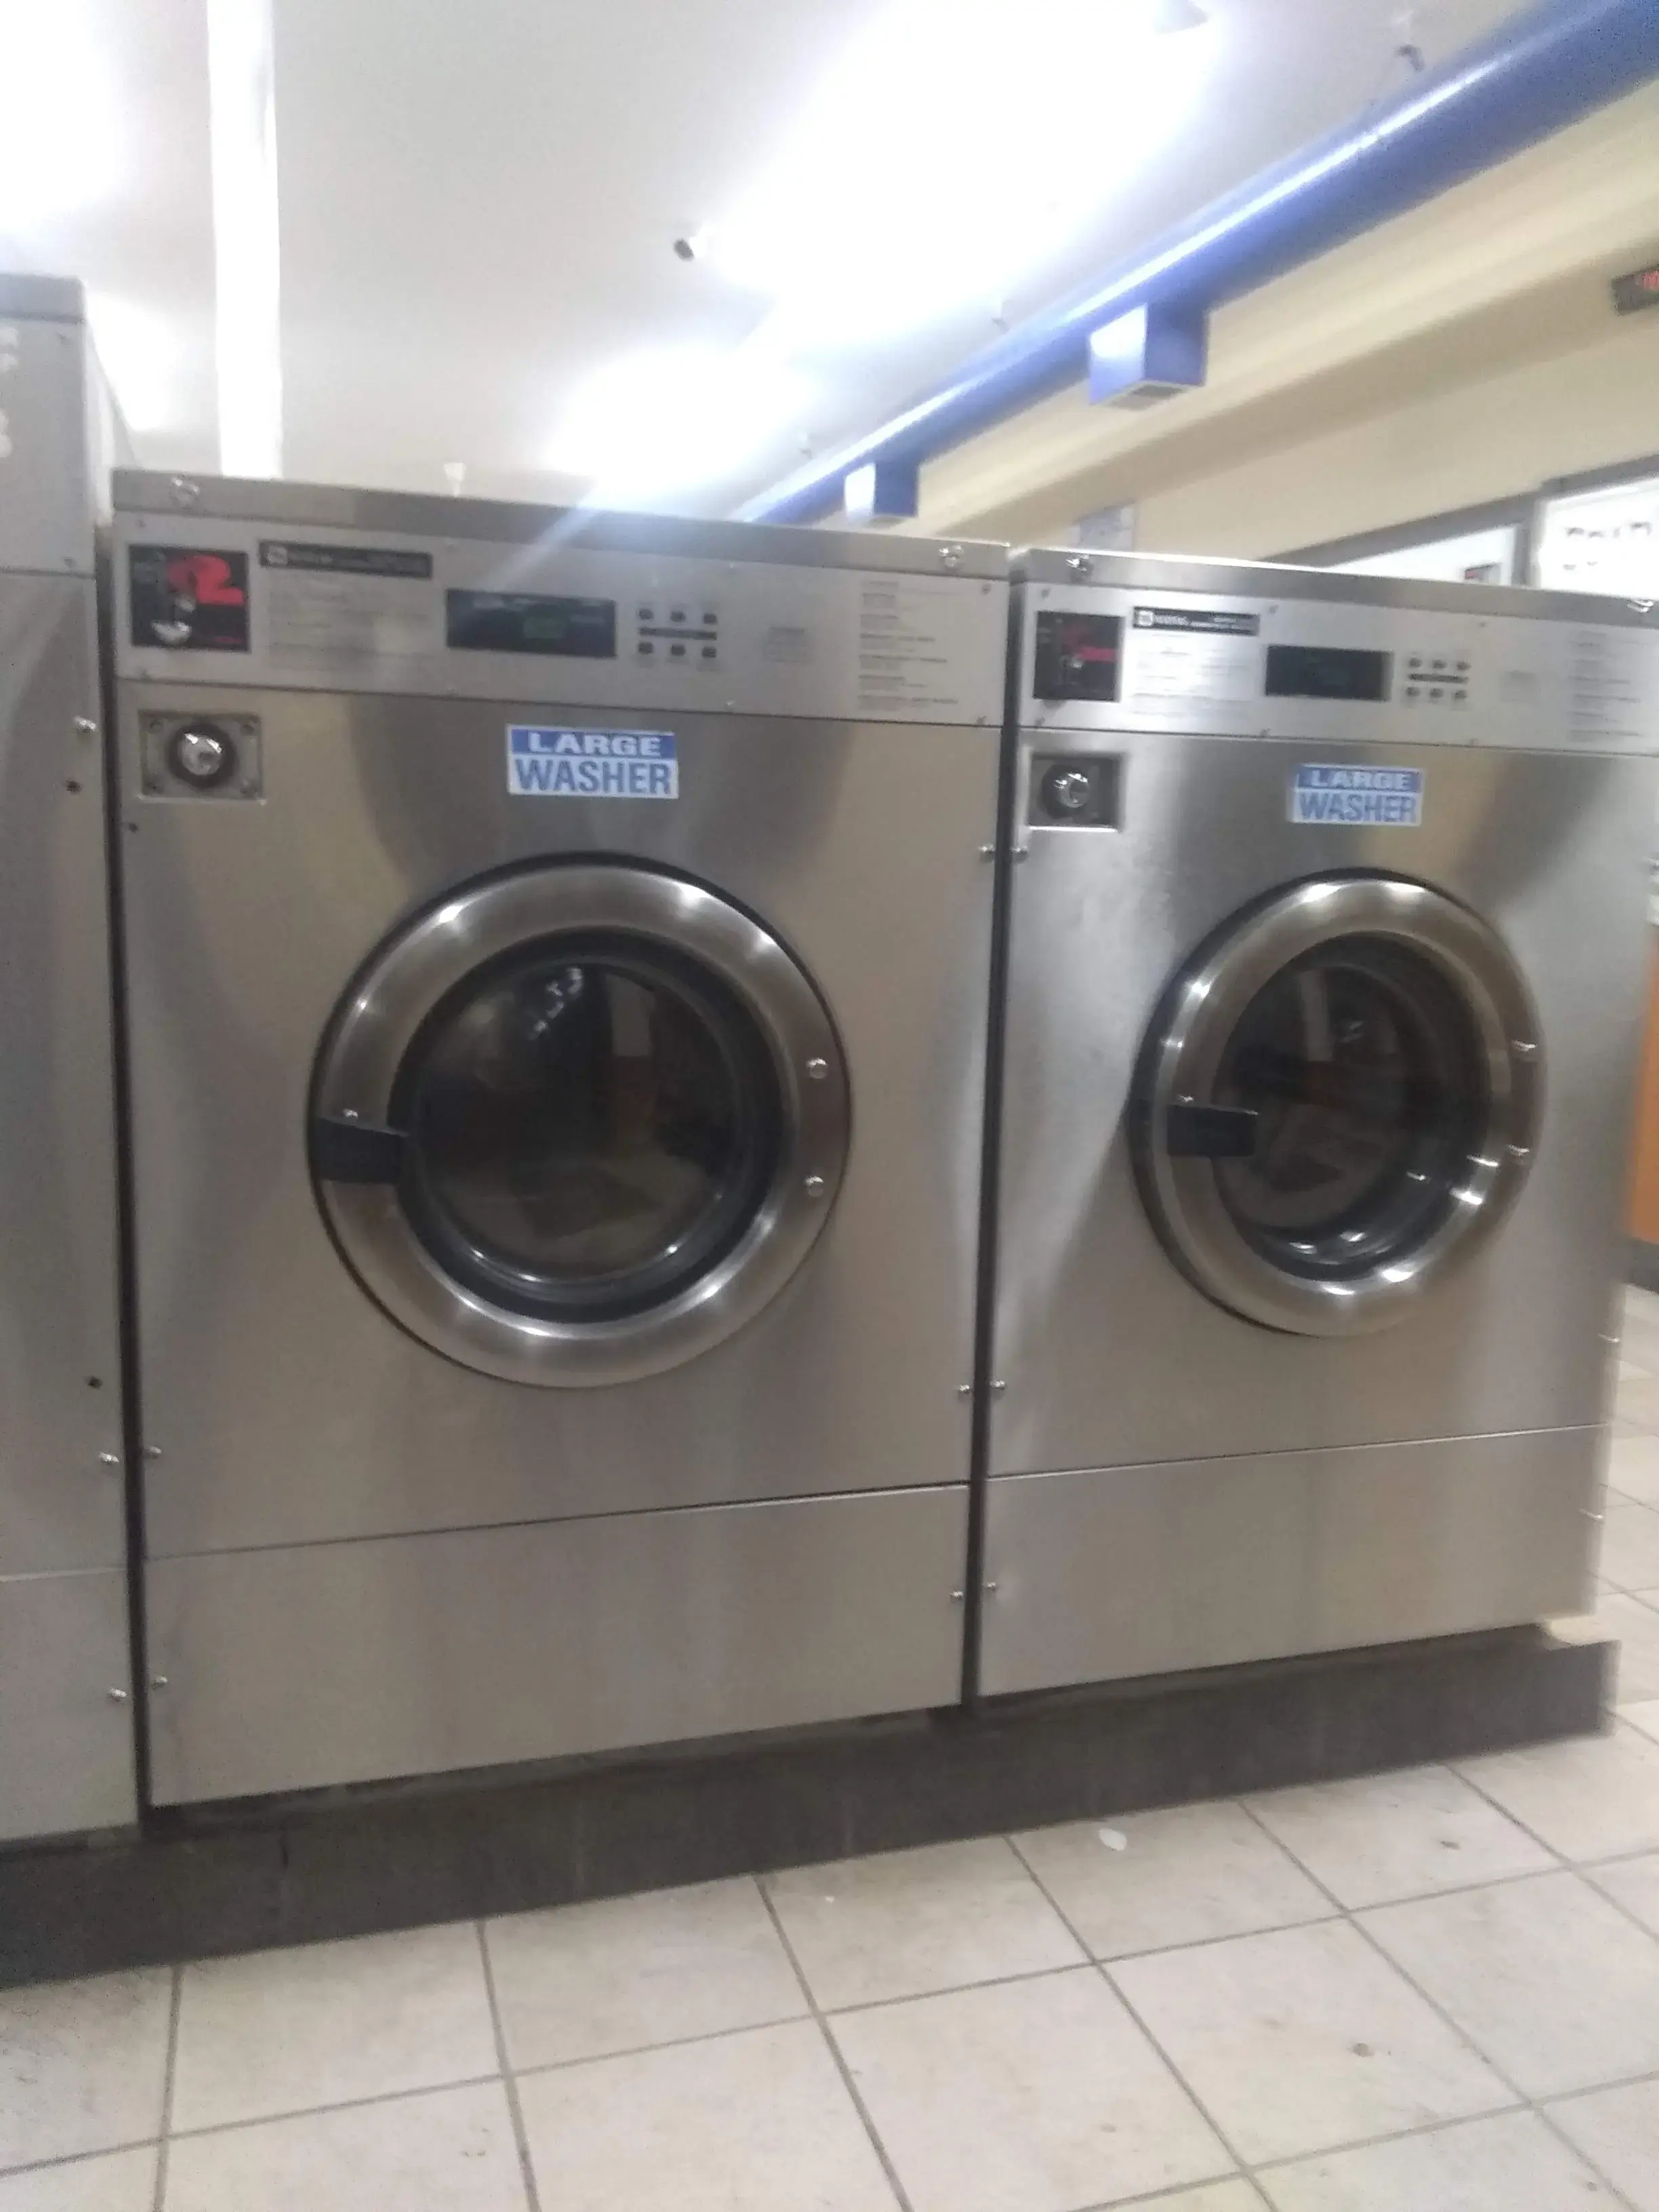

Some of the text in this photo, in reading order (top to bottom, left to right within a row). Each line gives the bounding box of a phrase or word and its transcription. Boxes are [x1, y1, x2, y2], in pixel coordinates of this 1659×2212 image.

[527, 731, 662, 758] LARGE
[514, 759, 672, 795] WASHER
[1311, 769, 1412, 790] LARGE
[1299, 792, 1417, 823] WASHER
